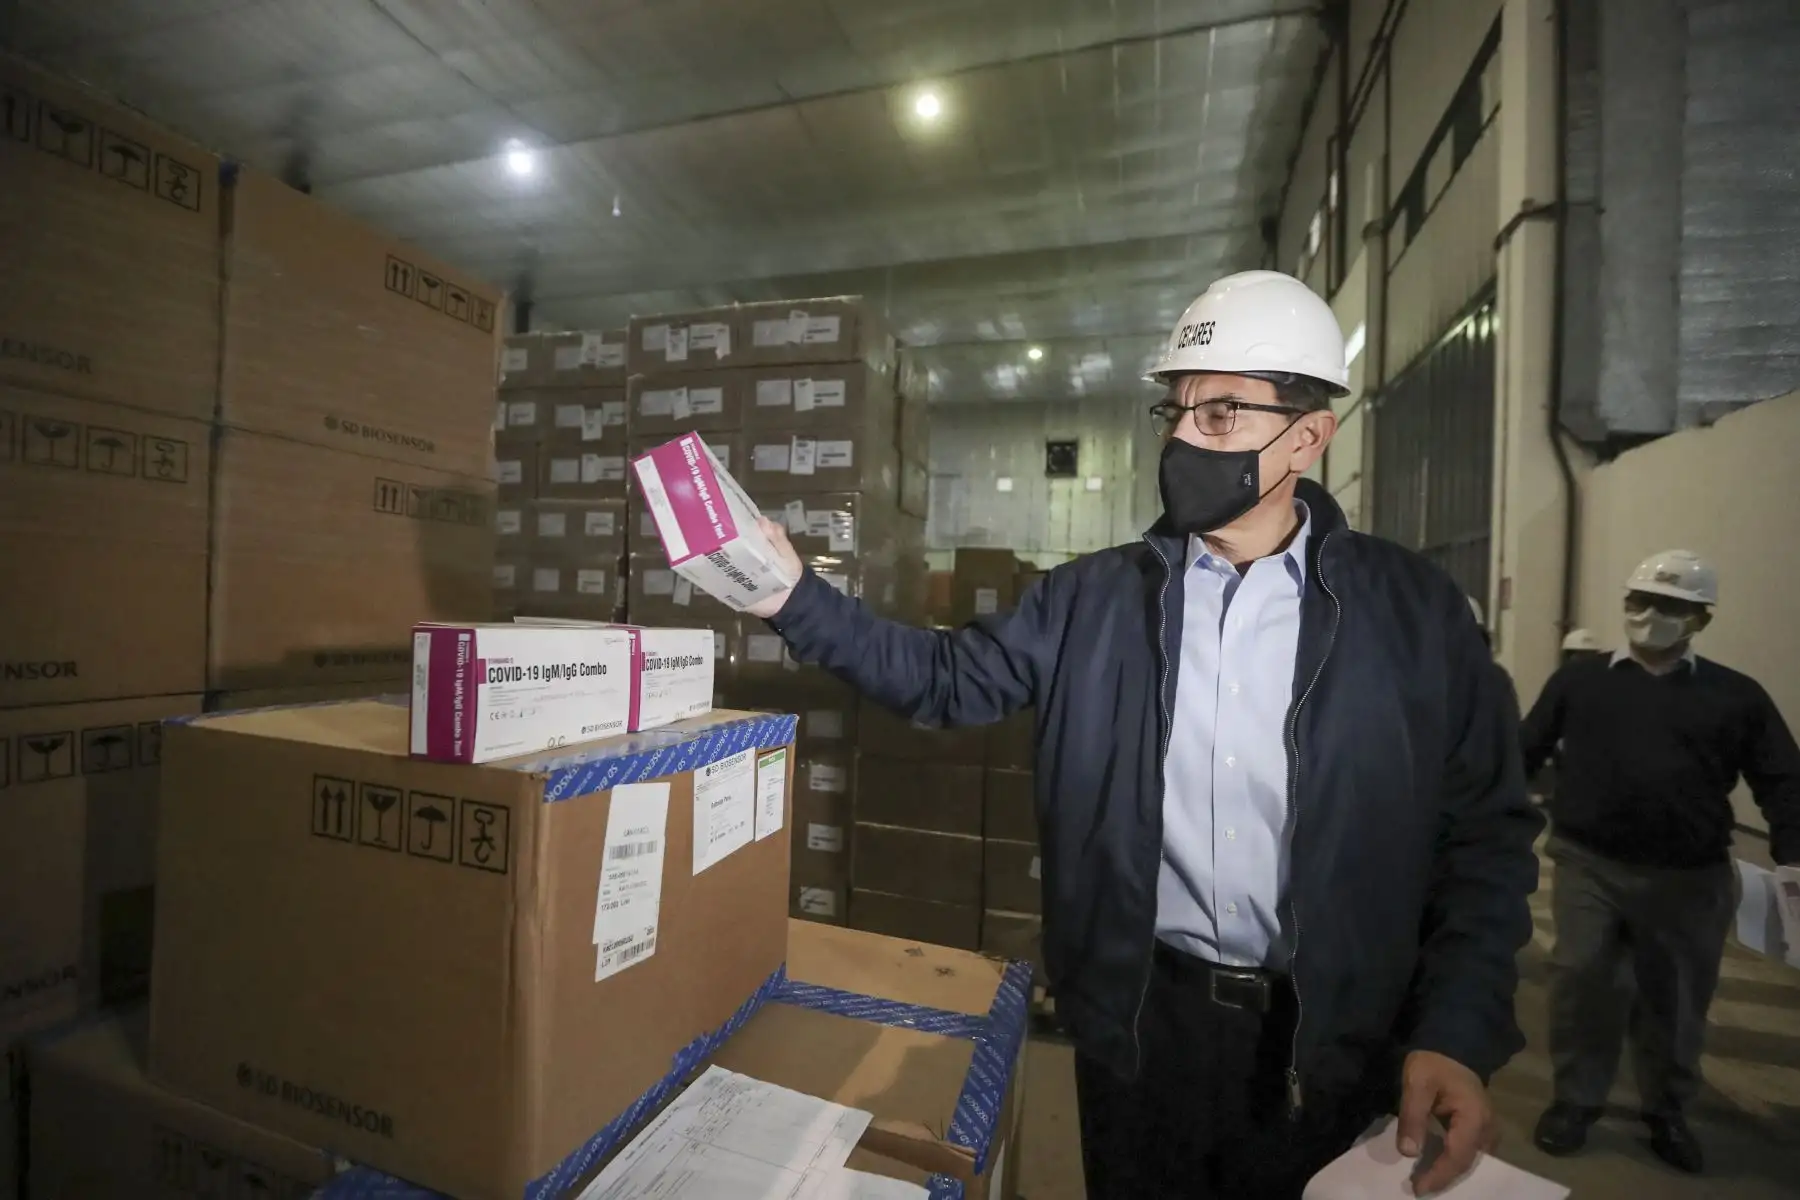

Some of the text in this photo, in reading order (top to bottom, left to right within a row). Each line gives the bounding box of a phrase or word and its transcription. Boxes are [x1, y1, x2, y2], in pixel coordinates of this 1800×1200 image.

[362, 425, 435, 453] BIOSENSOR
[714, 523, 726, 539] Test
[456, 641, 465, 678] COVID-19
[645, 657, 670, 672] COVID-19
[689, 654, 704, 667] Combo
[0, 660, 78, 681] NSOR
[488, 662, 607, 684] COVID-19 IgM/IgG Combo
[454, 711, 463, 738] Combo
[454, 740, 463, 756] Test
[720, 752, 747, 770] BIOSENSOR
[281, 1080, 394, 1139] BIOSENSOR
